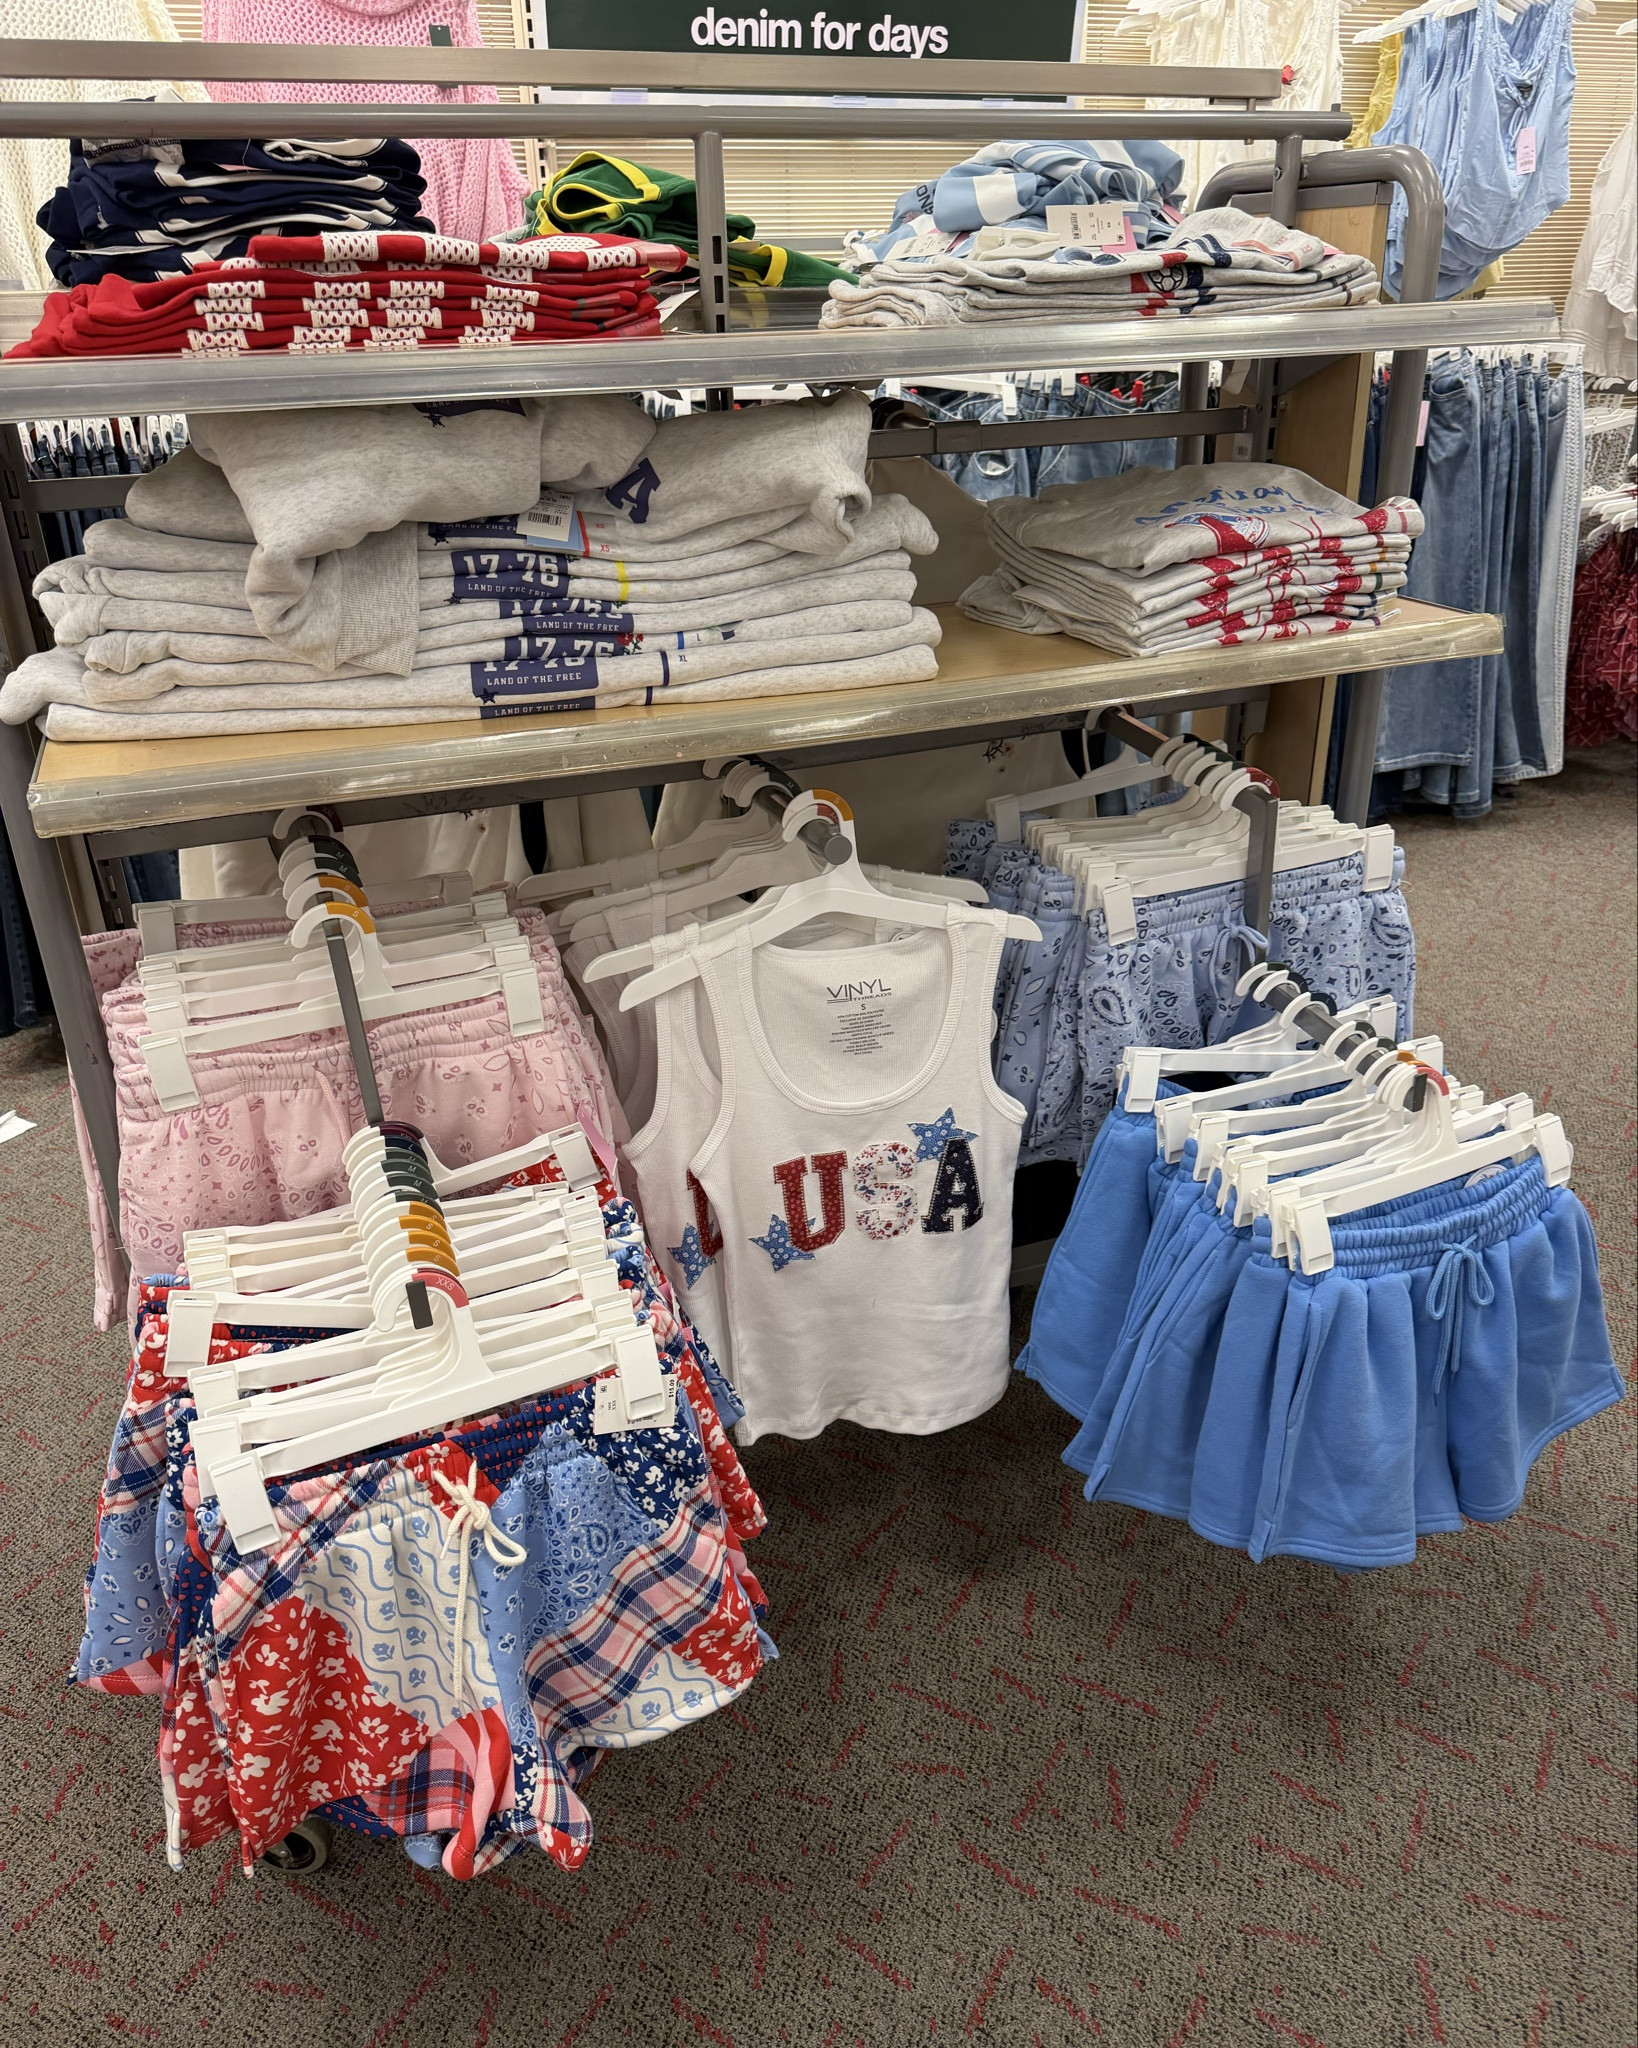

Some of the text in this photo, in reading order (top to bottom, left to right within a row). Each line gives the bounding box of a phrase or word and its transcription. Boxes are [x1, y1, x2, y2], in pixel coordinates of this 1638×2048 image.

[691, 7, 949, 60] denim for days
[600, 543, 611, 553] XS
[468, 583, 493, 592] LAND
[528, 588, 552, 598] FREE
[536, 621, 560, 629] LAND
[576, 622, 595, 630] THE
[597, 623, 620, 632] FREE
[696, 632, 702, 642] L
[678, 654, 688, 663] XL
[486, 672, 582, 686] LAND OF THE FREE
[494, 706, 520, 716] LAND
[522, 705, 534, 713] OF
[1264, 777, 1273, 786] XS
[336, 851, 344, 859] M
[339, 865, 347, 873] M
[826, 978, 892, 1001] VINYL
[852, 992, 893, 1001] THREADS
[407, 1143, 413, 1151] L
[407, 1165, 416, 1173] M
[413, 1179, 421, 1187] M
[773, 1137, 984, 1254] USA
[435, 1276, 455, 1291] XXS
